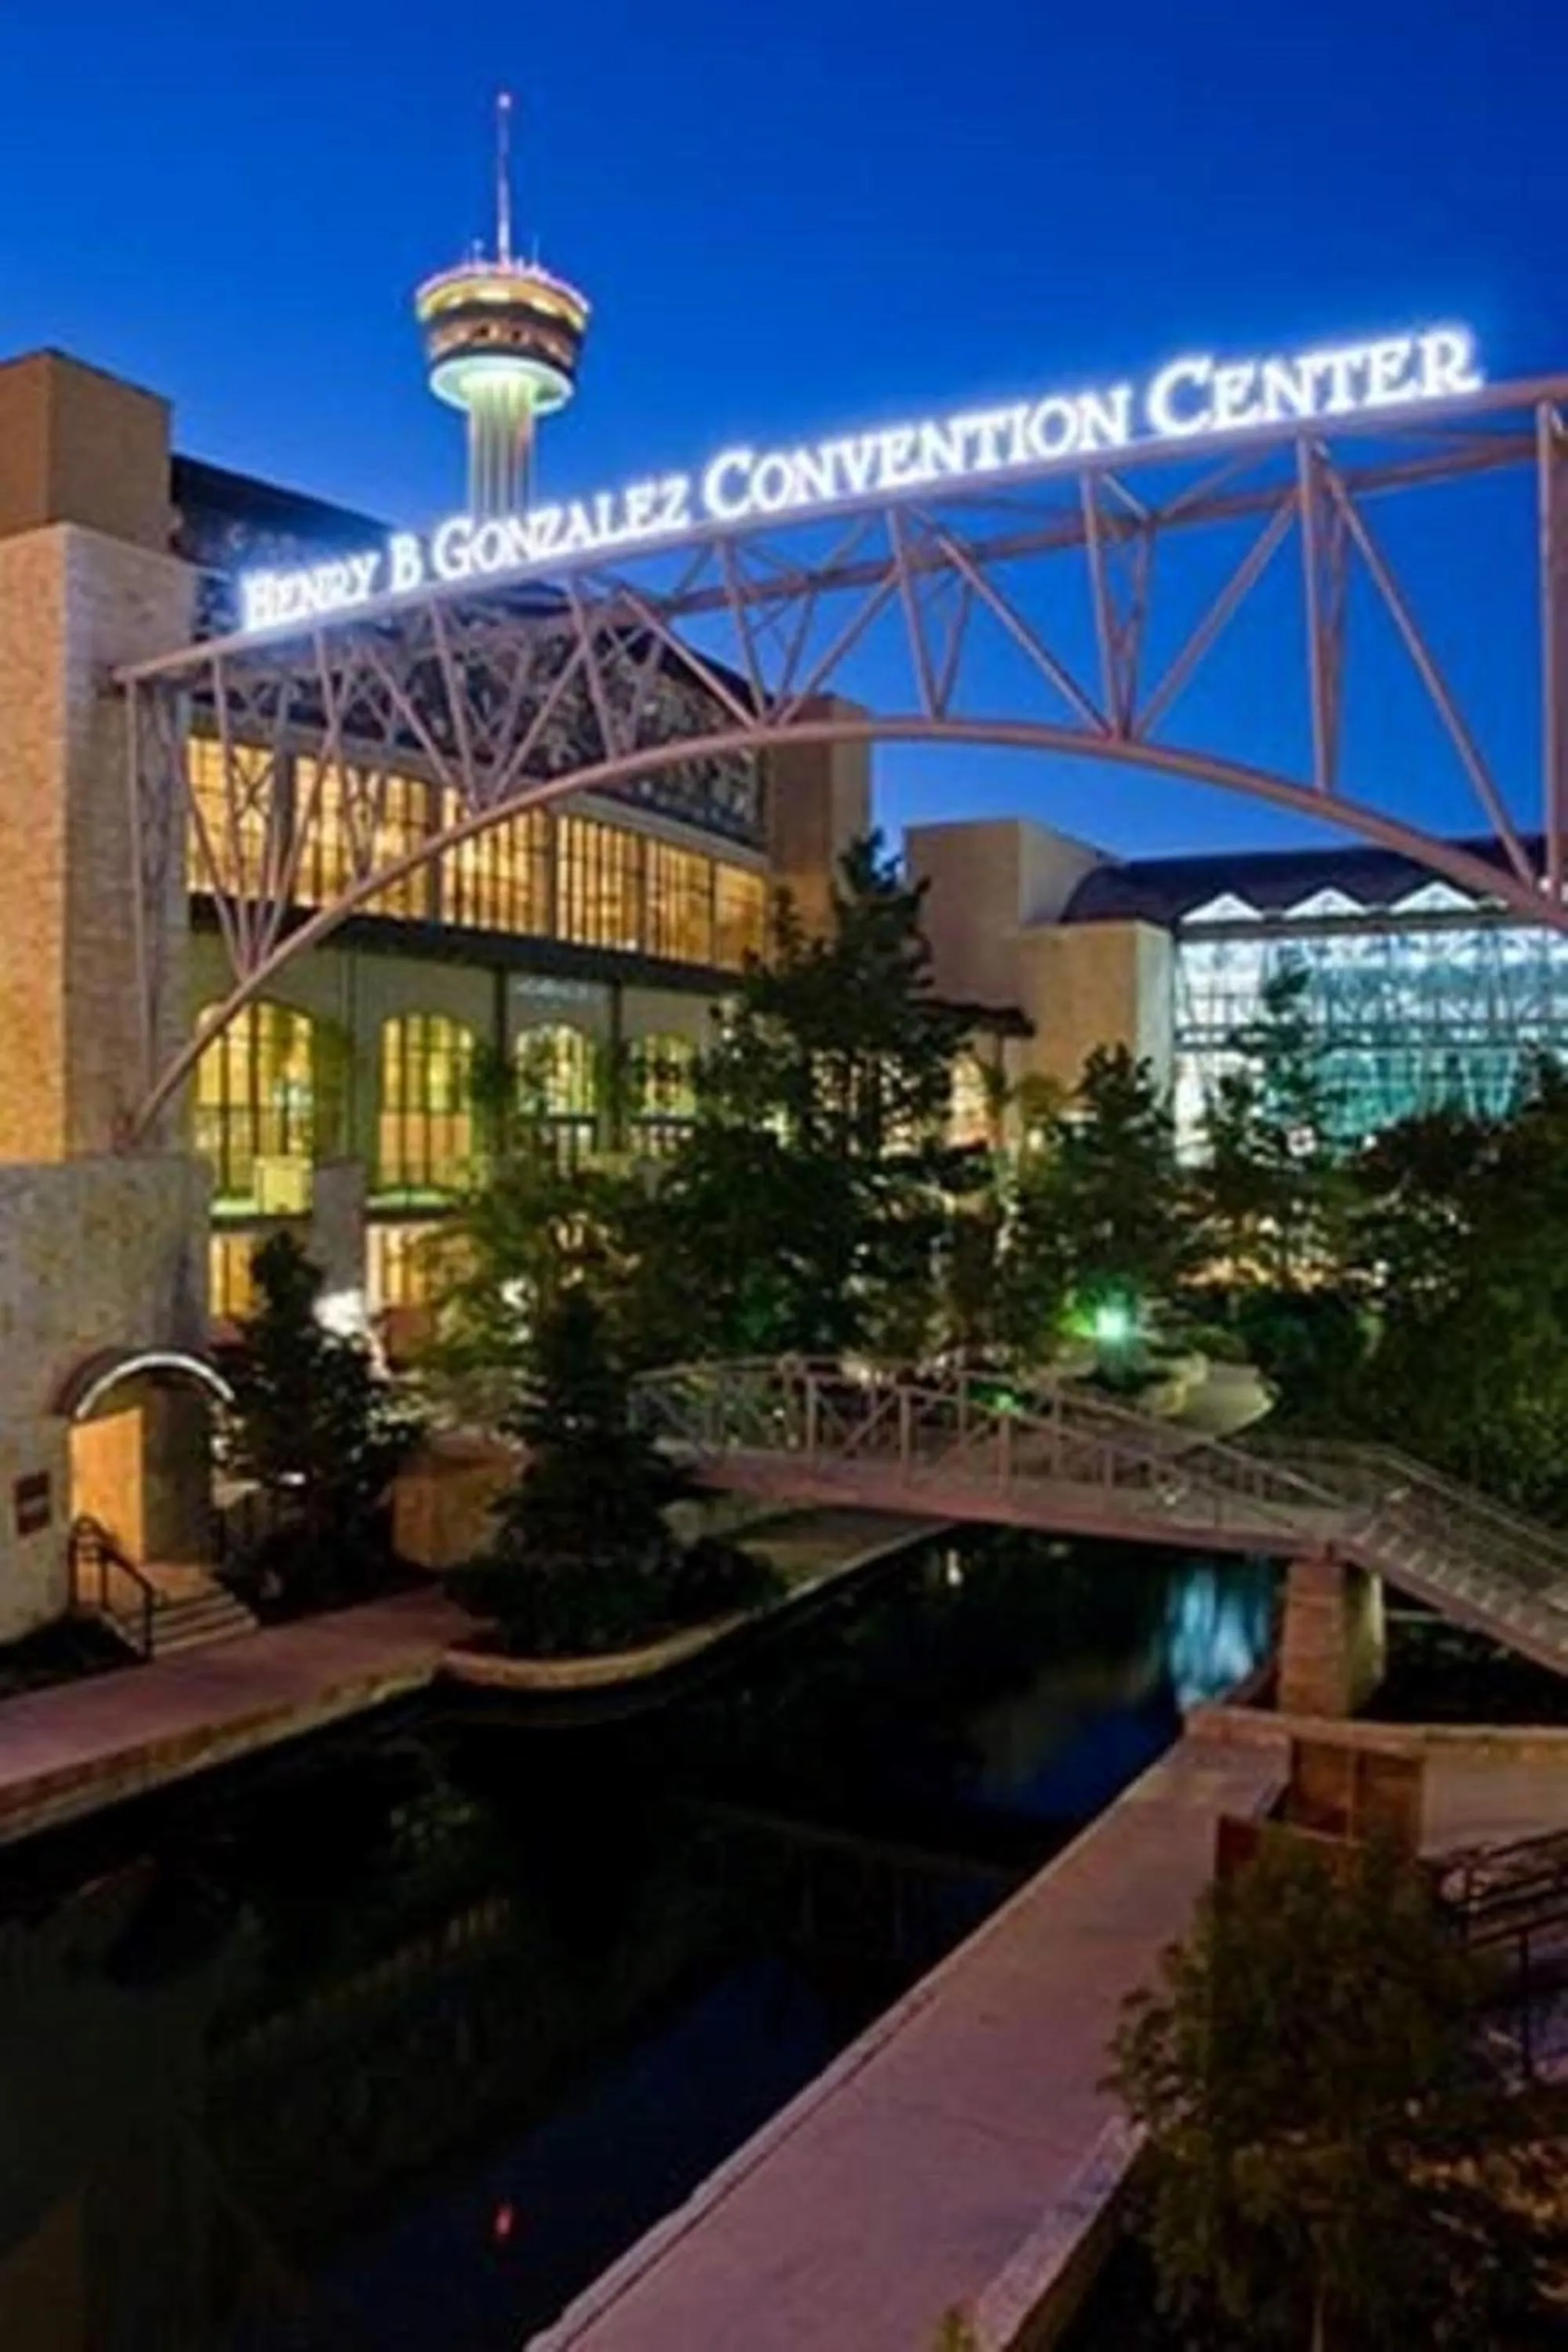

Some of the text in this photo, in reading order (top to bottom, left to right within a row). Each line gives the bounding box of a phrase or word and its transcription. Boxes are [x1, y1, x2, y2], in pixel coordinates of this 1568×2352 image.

[241, 328, 1482, 630] HENRY B GONZALEZ CONVENTION CENTER
